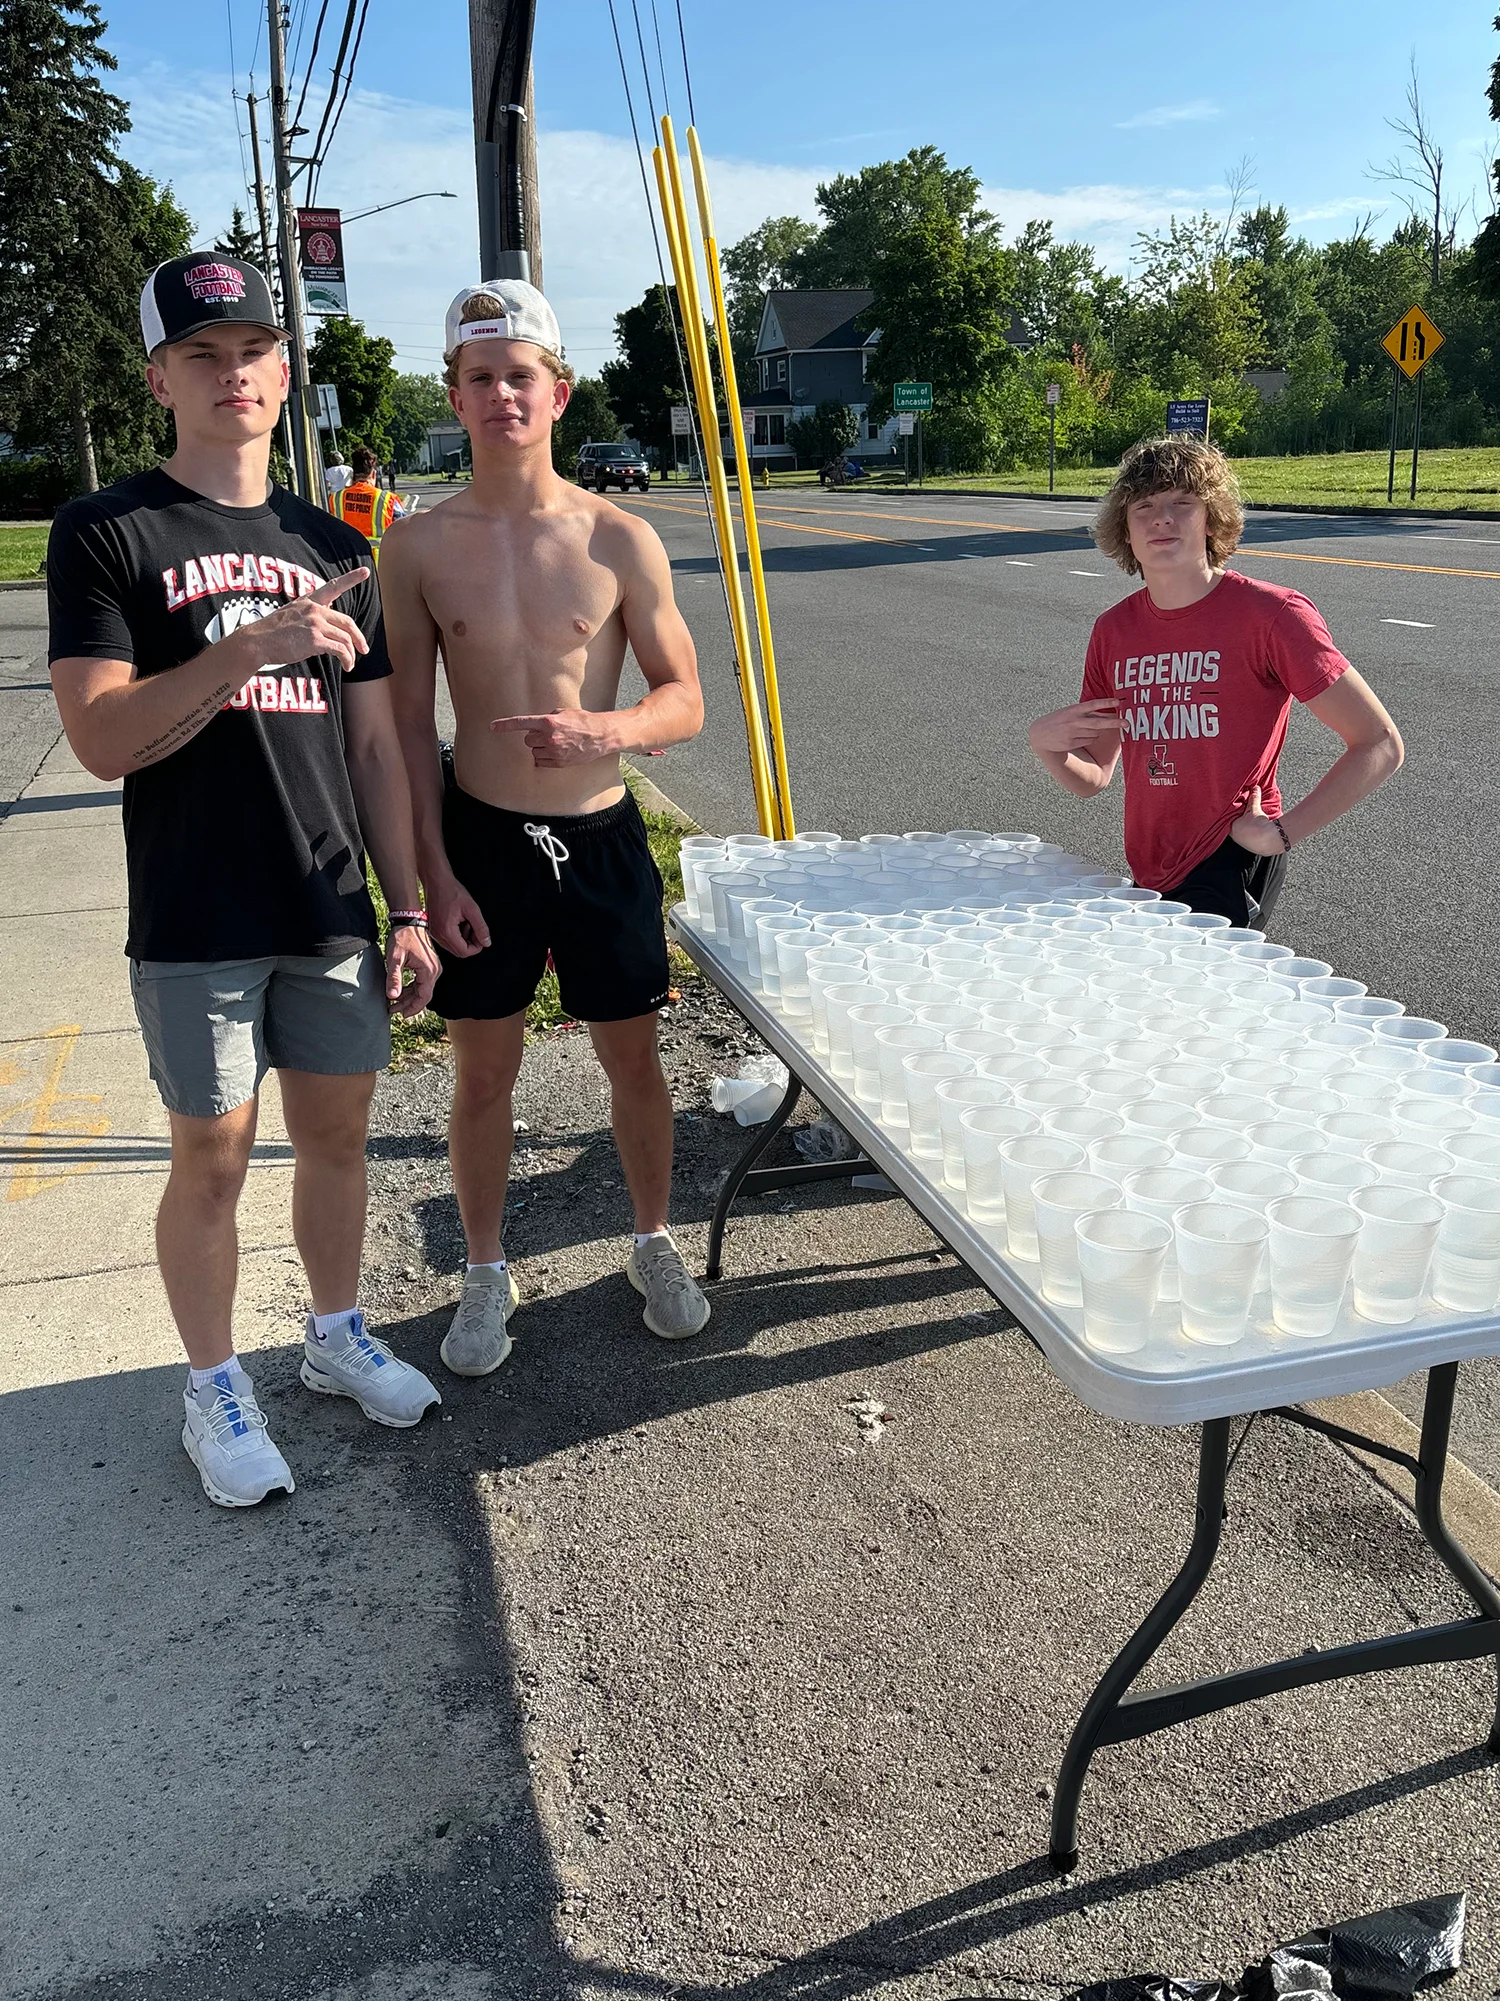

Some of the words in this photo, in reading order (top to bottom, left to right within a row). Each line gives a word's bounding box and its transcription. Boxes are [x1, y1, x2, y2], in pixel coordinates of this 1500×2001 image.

[300, 215, 340, 223] LANCASTER
[184, 262, 246, 287] LANCASTER
[191, 280, 247, 299] FOOTBALL
[470, 327, 498, 336] LEGENDS
[898, 387, 917, 395] Town
[921, 387, 928, 395] of
[896, 398, 930, 406] Lancaster
[346, 503, 355, 512] FIRE
[356, 504, 371, 514] POLICE
[1114, 650, 1221, 690] LEGENDS
[222, 675, 328, 713] OTBALL
[1133, 688, 1151, 705] IN
[1161, 685, 1193, 702] THE
[144, 732, 170, 752] Buffum
[169, 726, 178, 734] St
[176, 707, 203, 728] Buffalo,
[201, 696, 212, 708] NY
[211, 682, 231, 699] 14210
[157, 736, 182, 753] Norton
[180, 728, 192, 737] Rd
[206, 704, 219, 716] NY
[1149, 777, 1178, 786] FOOTBALL
